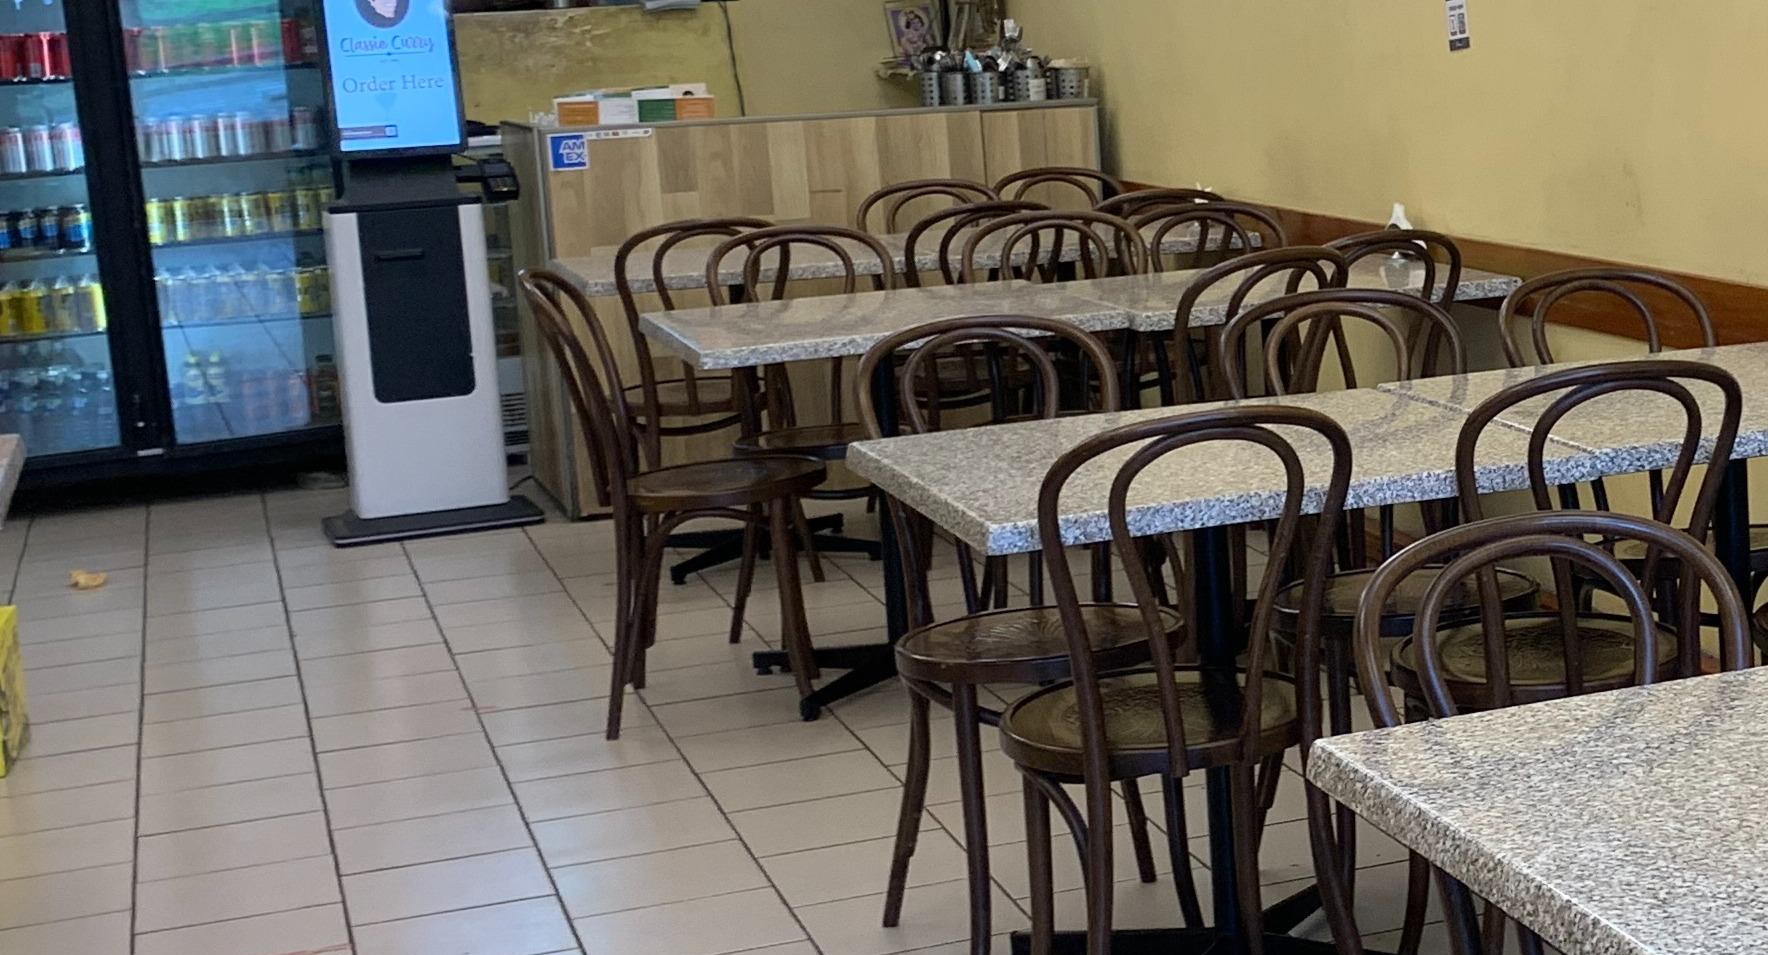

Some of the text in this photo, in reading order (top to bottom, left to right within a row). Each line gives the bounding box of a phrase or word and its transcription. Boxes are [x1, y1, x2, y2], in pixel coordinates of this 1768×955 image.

[340, 35, 435, 53] Classic Curry
[342, 74, 445, 94] Order Here
[561, 140, 585, 152] AM
[565, 151, 585, 162] EX
